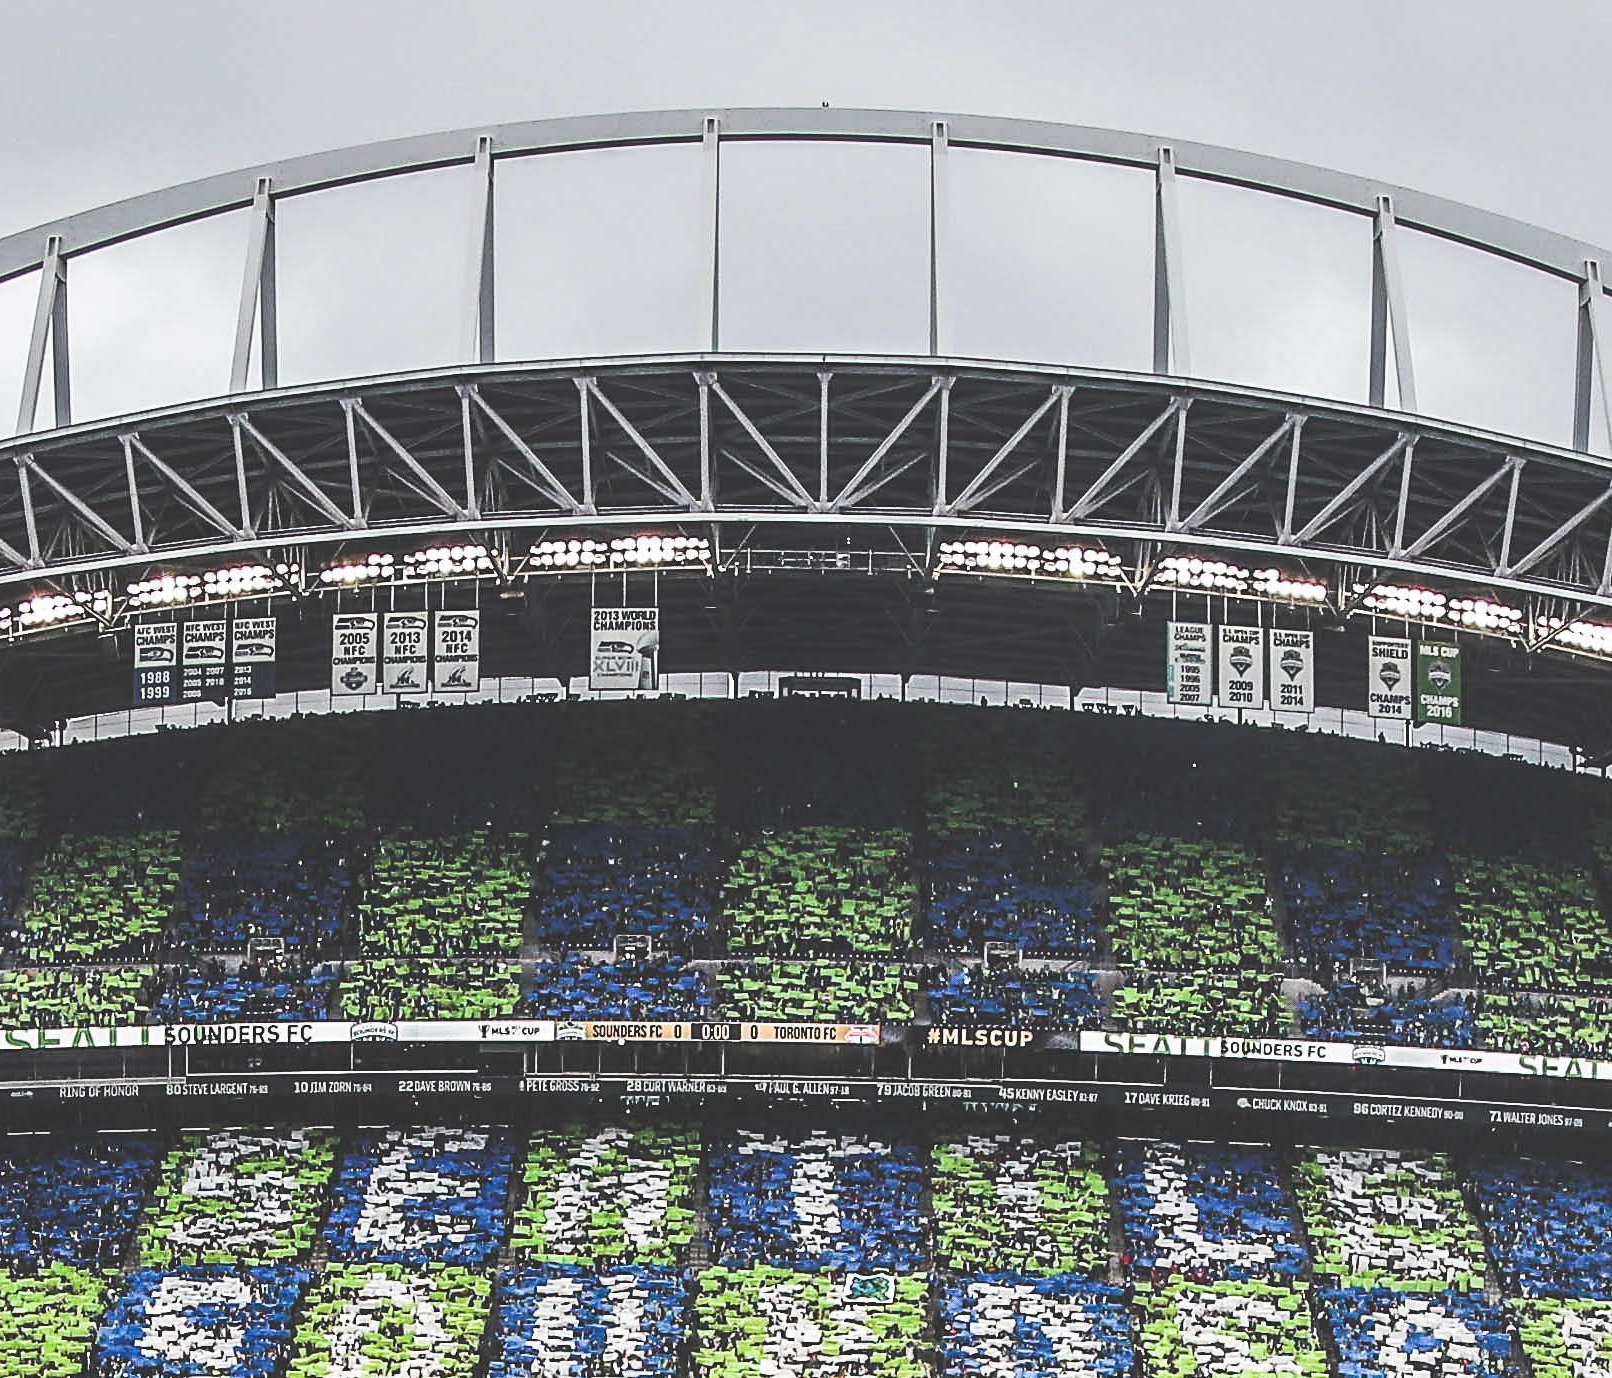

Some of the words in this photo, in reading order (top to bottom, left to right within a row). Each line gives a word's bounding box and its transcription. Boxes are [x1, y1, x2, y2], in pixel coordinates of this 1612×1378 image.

[593, 610, 619, 621] 2013
[621, 610, 656, 620] WORLD
[153, 625, 175, 634] WEST
[203, 622, 225, 631] WEST
[251, 620, 275, 629] WEST
[593, 620, 656, 631] CHAMPIONS
[136, 634, 175, 646] CHAMPS
[185, 632, 225, 643] CHAMPS
[235, 629, 274, 640] CHAMPS
[340, 632, 370, 645] 2005
[390, 632, 421, 645] 2013
[441, 631, 472, 643] 2014
[1174, 634, 1206, 642] CHAMPS
[1223, 635, 1259, 645] CHAMPS
[445, 644, 469, 653] NFC
[1273, 638, 1310, 648] CHAMPS
[344, 646, 365, 656] NFC
[394, 645, 416, 655] NFC
[1372, 647, 1408, 659] SHIELD
[1419, 645, 1439, 656] MLS
[1440, 646, 1459, 658] CUP
[593, 660, 639, 672] XLVIII
[140, 671, 170, 684] 1988
[1229, 680, 1253, 691] 2009
[1280, 684, 1302, 694] 2011
[140, 686, 170, 699] 1999
[1229, 692, 1252, 702] 2010
[1280, 695, 1303, 705] 2014
[1370, 693, 1410, 705] CHAMPS
[1420, 694, 1459, 707] CHAMPS
[1379, 704, 1402, 714] 2014
[1427, 705, 1452, 718] 2016
[165, 1025, 280, 1045] SOUNDERS
[287, 1025, 313, 1043] FC
[491, 1026, 510, 1036] MLS
[521, 1026, 541, 1036] CUP
[592, 1024, 647, 1039] SOUNDERS
[650, 1024, 663, 1039] FC
[674, 1024, 682, 1039] 0
[701, 1024, 730, 1040] 0:00
[750, 1025, 759, 1040] 0
[774, 1025, 821, 1040] TORONTO
[823, 1026, 837, 1040] FC
[927, 1028, 1034, 1047] #MLSCUP
[1221, 1038, 1303, 1058] SOUNDERS
[1307, 1045, 1327, 1059] FC
[59, 1086, 86, 1099] RING
[89, 1085, 101, 1098] OF
[104, 1084, 139, 1097] HONOR
[166, 1084, 181, 1096] 80
[183, 1083, 208, 1095] STEVE
[210, 1083, 248, 1095] LARGENT
[294, 1081, 309, 1093] 10
[310, 1081, 327, 1093] JIM
[329, 1081, 352, 1092] ZORN
[398, 1080, 414, 1092] 22
[415, 1081, 436, 1092] DAVE
[438, 1081, 471, 1092] BROWN
[526, 1081, 548, 1092] PETE
[549, 1081, 580, 1092] GROSS
[627, 1082, 642, 1092] 28
[643, 1082, 666, 1093] CURT
[668, 1082, 706, 1093] WARNER
[768, 1083, 790, 1094] PAUL
[803, 1083, 830, 1095] ALLEN
[876, 1084, 892, 1096] 79
[893, 1085, 920, 1097] JACOB
[922, 1085, 951, 1098] GREEN
[999, 1088, 1015, 1100] 45
[1016, 1088, 1045, 1101] KENNY
[1047, 1089, 1079, 1102] EASLEY
[1124, 1092, 1138, 1104] 17
[1139, 1092, 1161, 1105] DAVE
[1162, 1093, 1190, 1106] KRIEG
[1252, 1098, 1282, 1111] CHUCK
[1284, 1099, 1308, 1112] KNOX
[1353, 1102, 1369, 1115] 96
[1370, 1103, 1402, 1117] CORTEZ
[1404, 1104, 1443, 1120] KENNEDY
[1490, 1110, 1502, 1123] 71
[1503, 1111, 1536, 1125] WALTER
[1537, 1112, 1564, 1127] JONES
